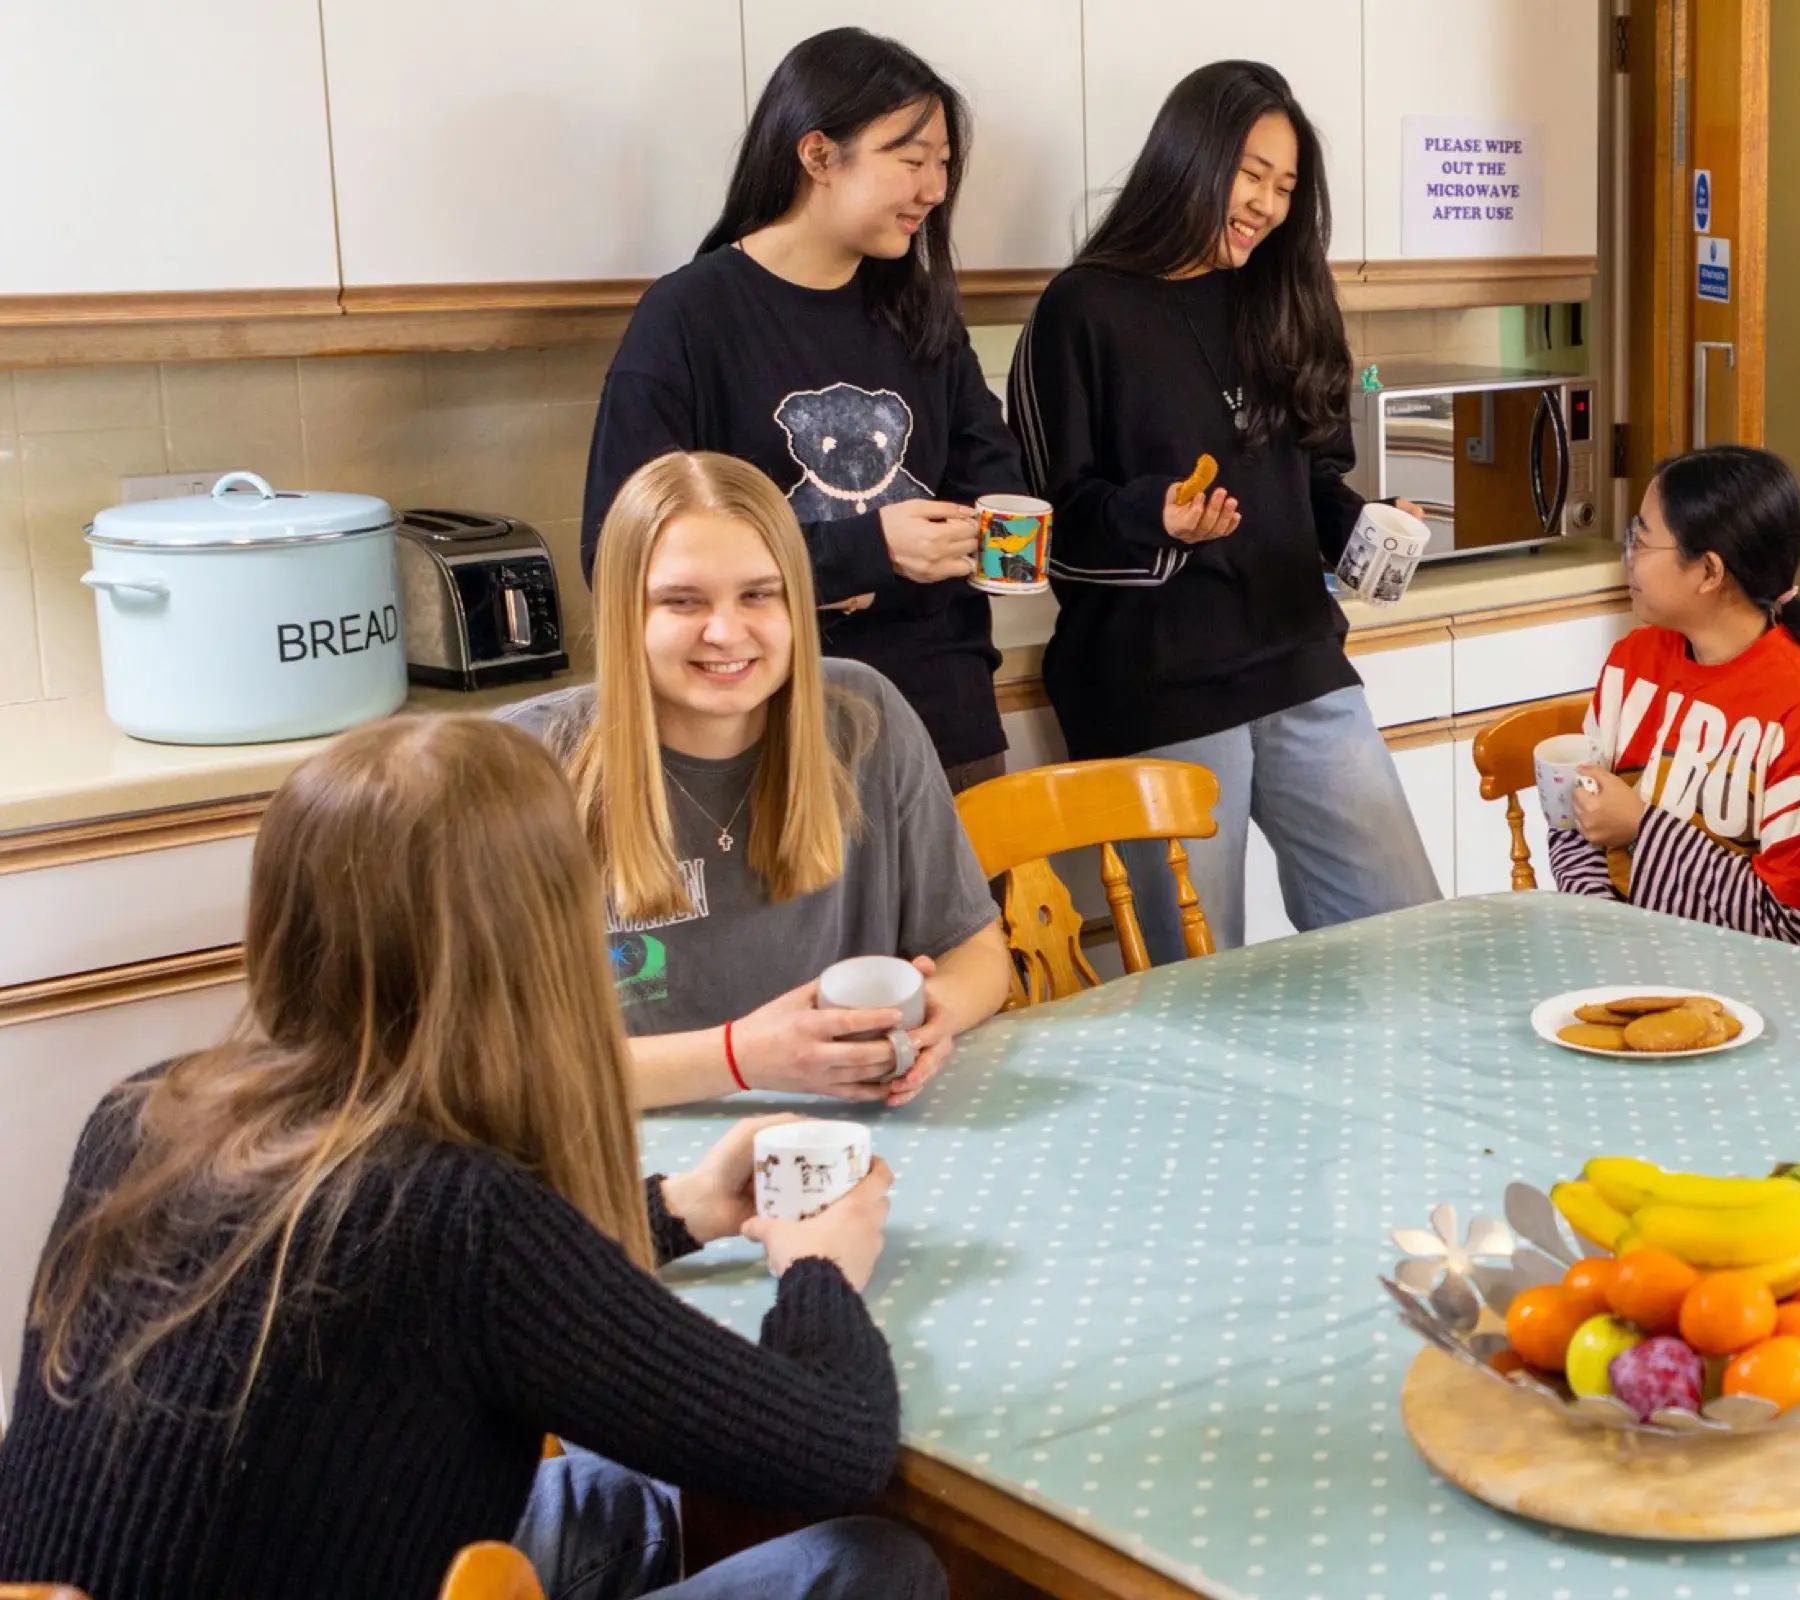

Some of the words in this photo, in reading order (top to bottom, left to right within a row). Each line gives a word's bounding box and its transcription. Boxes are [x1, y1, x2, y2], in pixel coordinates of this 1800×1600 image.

[1425, 138, 1482, 153] PLEASE
[1486, 140, 1523, 154] WIPE
[1442, 161, 1474, 175] OUT
[1477, 162, 1507, 176] THE
[1426, 183, 1521, 198] MICROWAVE
[1433, 206, 1482, 220] AFTER
[1486, 207, 1514, 220] USE
[277, 604, 398, 663] BREAD
